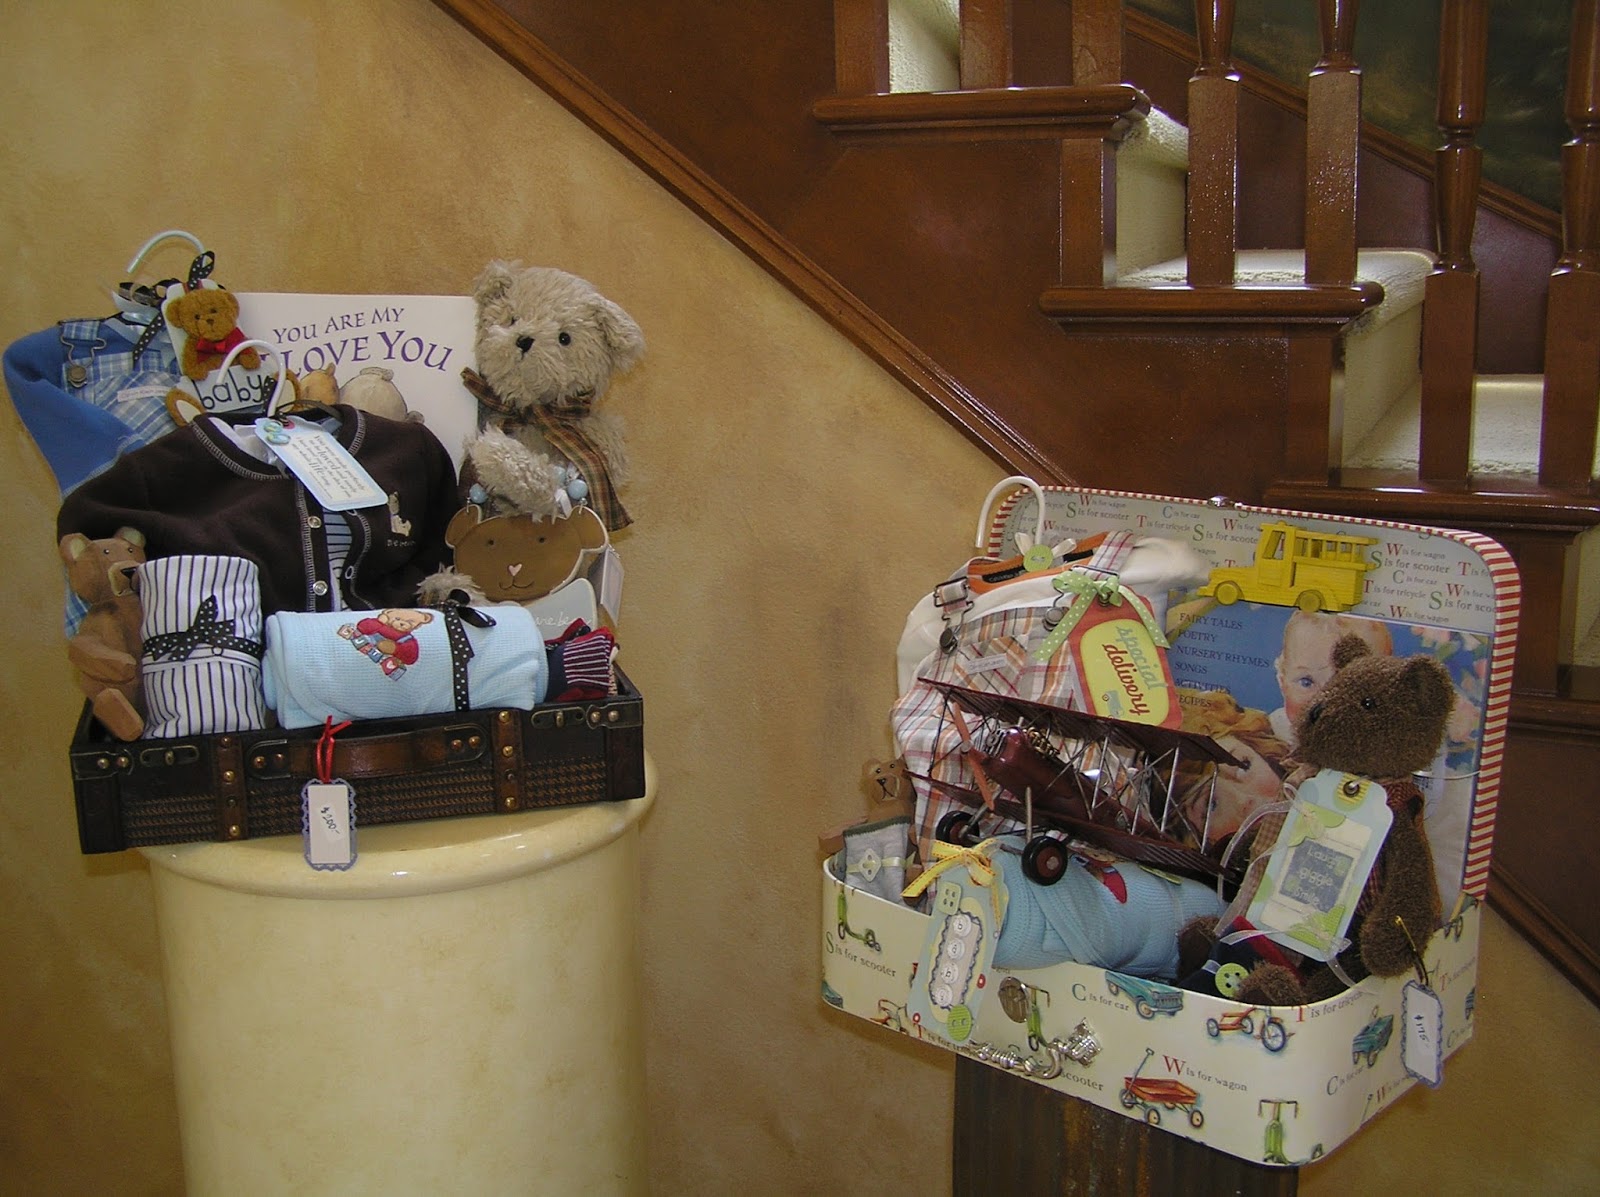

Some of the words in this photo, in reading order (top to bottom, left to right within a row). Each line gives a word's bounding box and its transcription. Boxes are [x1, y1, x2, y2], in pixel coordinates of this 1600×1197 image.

[272, 324, 317, 344] YOU
[324, 312, 366, 334] ARE
[371, 307, 405, 324] MY
[280, 336, 371, 378] LOVE
[377, 330, 453, 372] YOU
[190, 368, 264, 411] baby
[1087, 509, 1098, 517] for
[1101, 512, 1129, 520] scooter
[1165, 522, 1190, 532] tricycle
[1215, 531, 1228, 540] for
[1231, 534, 1258, 543] scoote
[1396, 559, 1410, 569] for
[1413, 562, 1450, 573] scooter
[1396, 587, 1426, 599] tricycle
[1456, 600, 1472, 611] for
[1180, 612, 1211, 624] FAIRY
[1210, 617, 1243, 629] TALES
[1177, 628, 1217, 642] POETRY
[1115, 625, 1169, 690] special
[1176, 645, 1223, 660] NURSERY
[1225, 652, 1270, 668] RHYMES
[1175, 661, 1208, 674] SONGS
[1101, 643, 1151, 716] delivery
[1178, 694, 1212, 708] ECIPES
[1306, 847, 1341, 870] Laug
[844, 948, 858, 962] for
[860, 957, 897, 977] scooter
[1072, 983, 1086, 1001] C
[1099, 995, 1112, 1006] for
[1114, 1001, 1129, 1011] car
[1323, 1004, 1338, 1015] for
[1060, 1069, 1104, 1091] scooter
[1162, 1054, 1187, 1075] W
[1186, 1067, 1195, 1077] is
[1198, 1070, 1212, 1081] for
[1215, 1077, 1248, 1092] wagon
